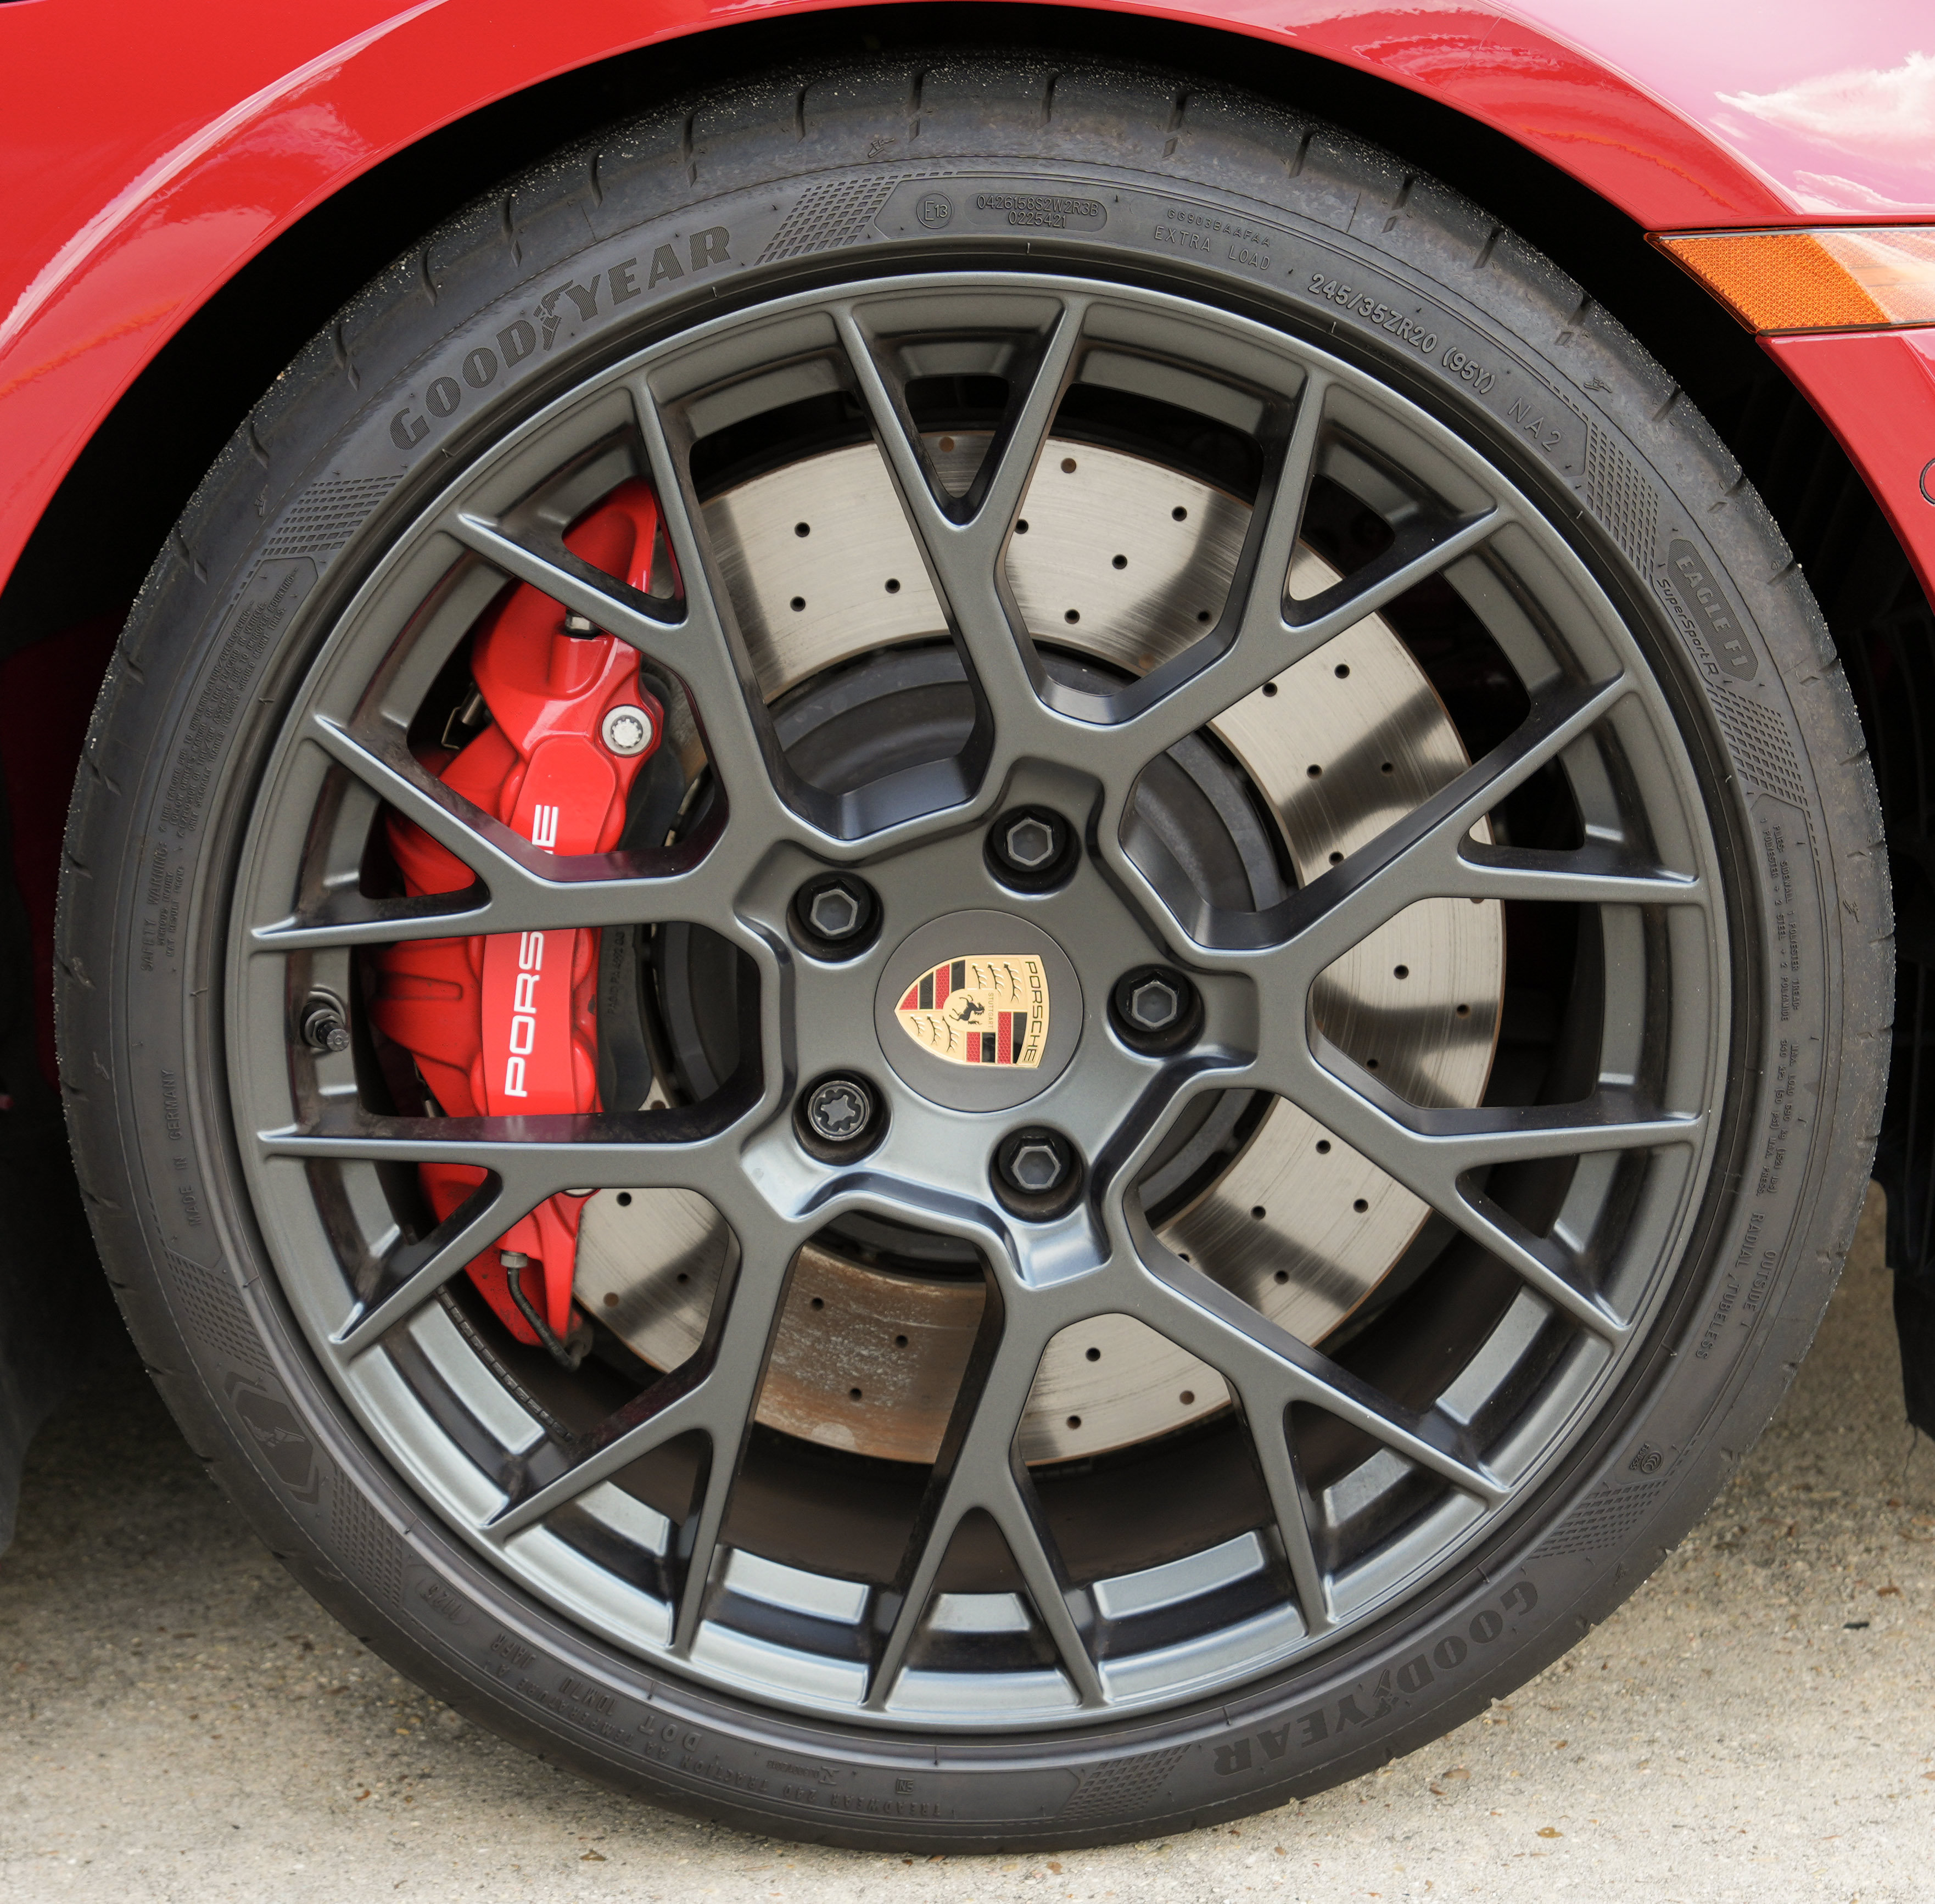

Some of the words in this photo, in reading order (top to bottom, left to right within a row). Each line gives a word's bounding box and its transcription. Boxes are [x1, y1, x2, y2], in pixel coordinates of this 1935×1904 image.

[977, 194, 1099, 218] 0426158S2W2R3B
[1008, 211, 1067, 229] 0225421
[1154, 224, 1213, 254] EXTRA
[1227, 244, 1271, 272] LOAD
[389, 225, 731, 451] GOODYEAR
[1307, 272, 1440, 355] 245/35ZR20
[1439, 344, 1498, 396] (95Y)
[1654, 576, 1710, 662] SuperSport
[1702, 658, 1719, 678] R
[1674, 553, 1731, 634] EAGLE
[1763, 830, 1779, 878] POLYESTER
[1776, 913, 1786, 940] STEEL
[1780, 860, 1793, 903] SIDEWALL
[1788, 922, 1799, 971] POLYESTER
[141, 917, 156, 971] SAFETY
[1022, 961, 1043, 1063] PORSCHE
[160, 1068, 183, 1140] GERMANY
[1786, 1074, 1796, 1095] LOAD
[172, 1155, 188, 1171] IN
[178, 1184, 202, 1227] MADE
[1735, 1210, 1765, 1270] RADIAL
[1743, 1247, 1776, 1312] OUTSIDE
[1694, 1280, 1741, 1362] TUBELESS
[1211, 1581, 1539, 1777] GOODYEAR
[636, 1712, 702, 1753] DOT
